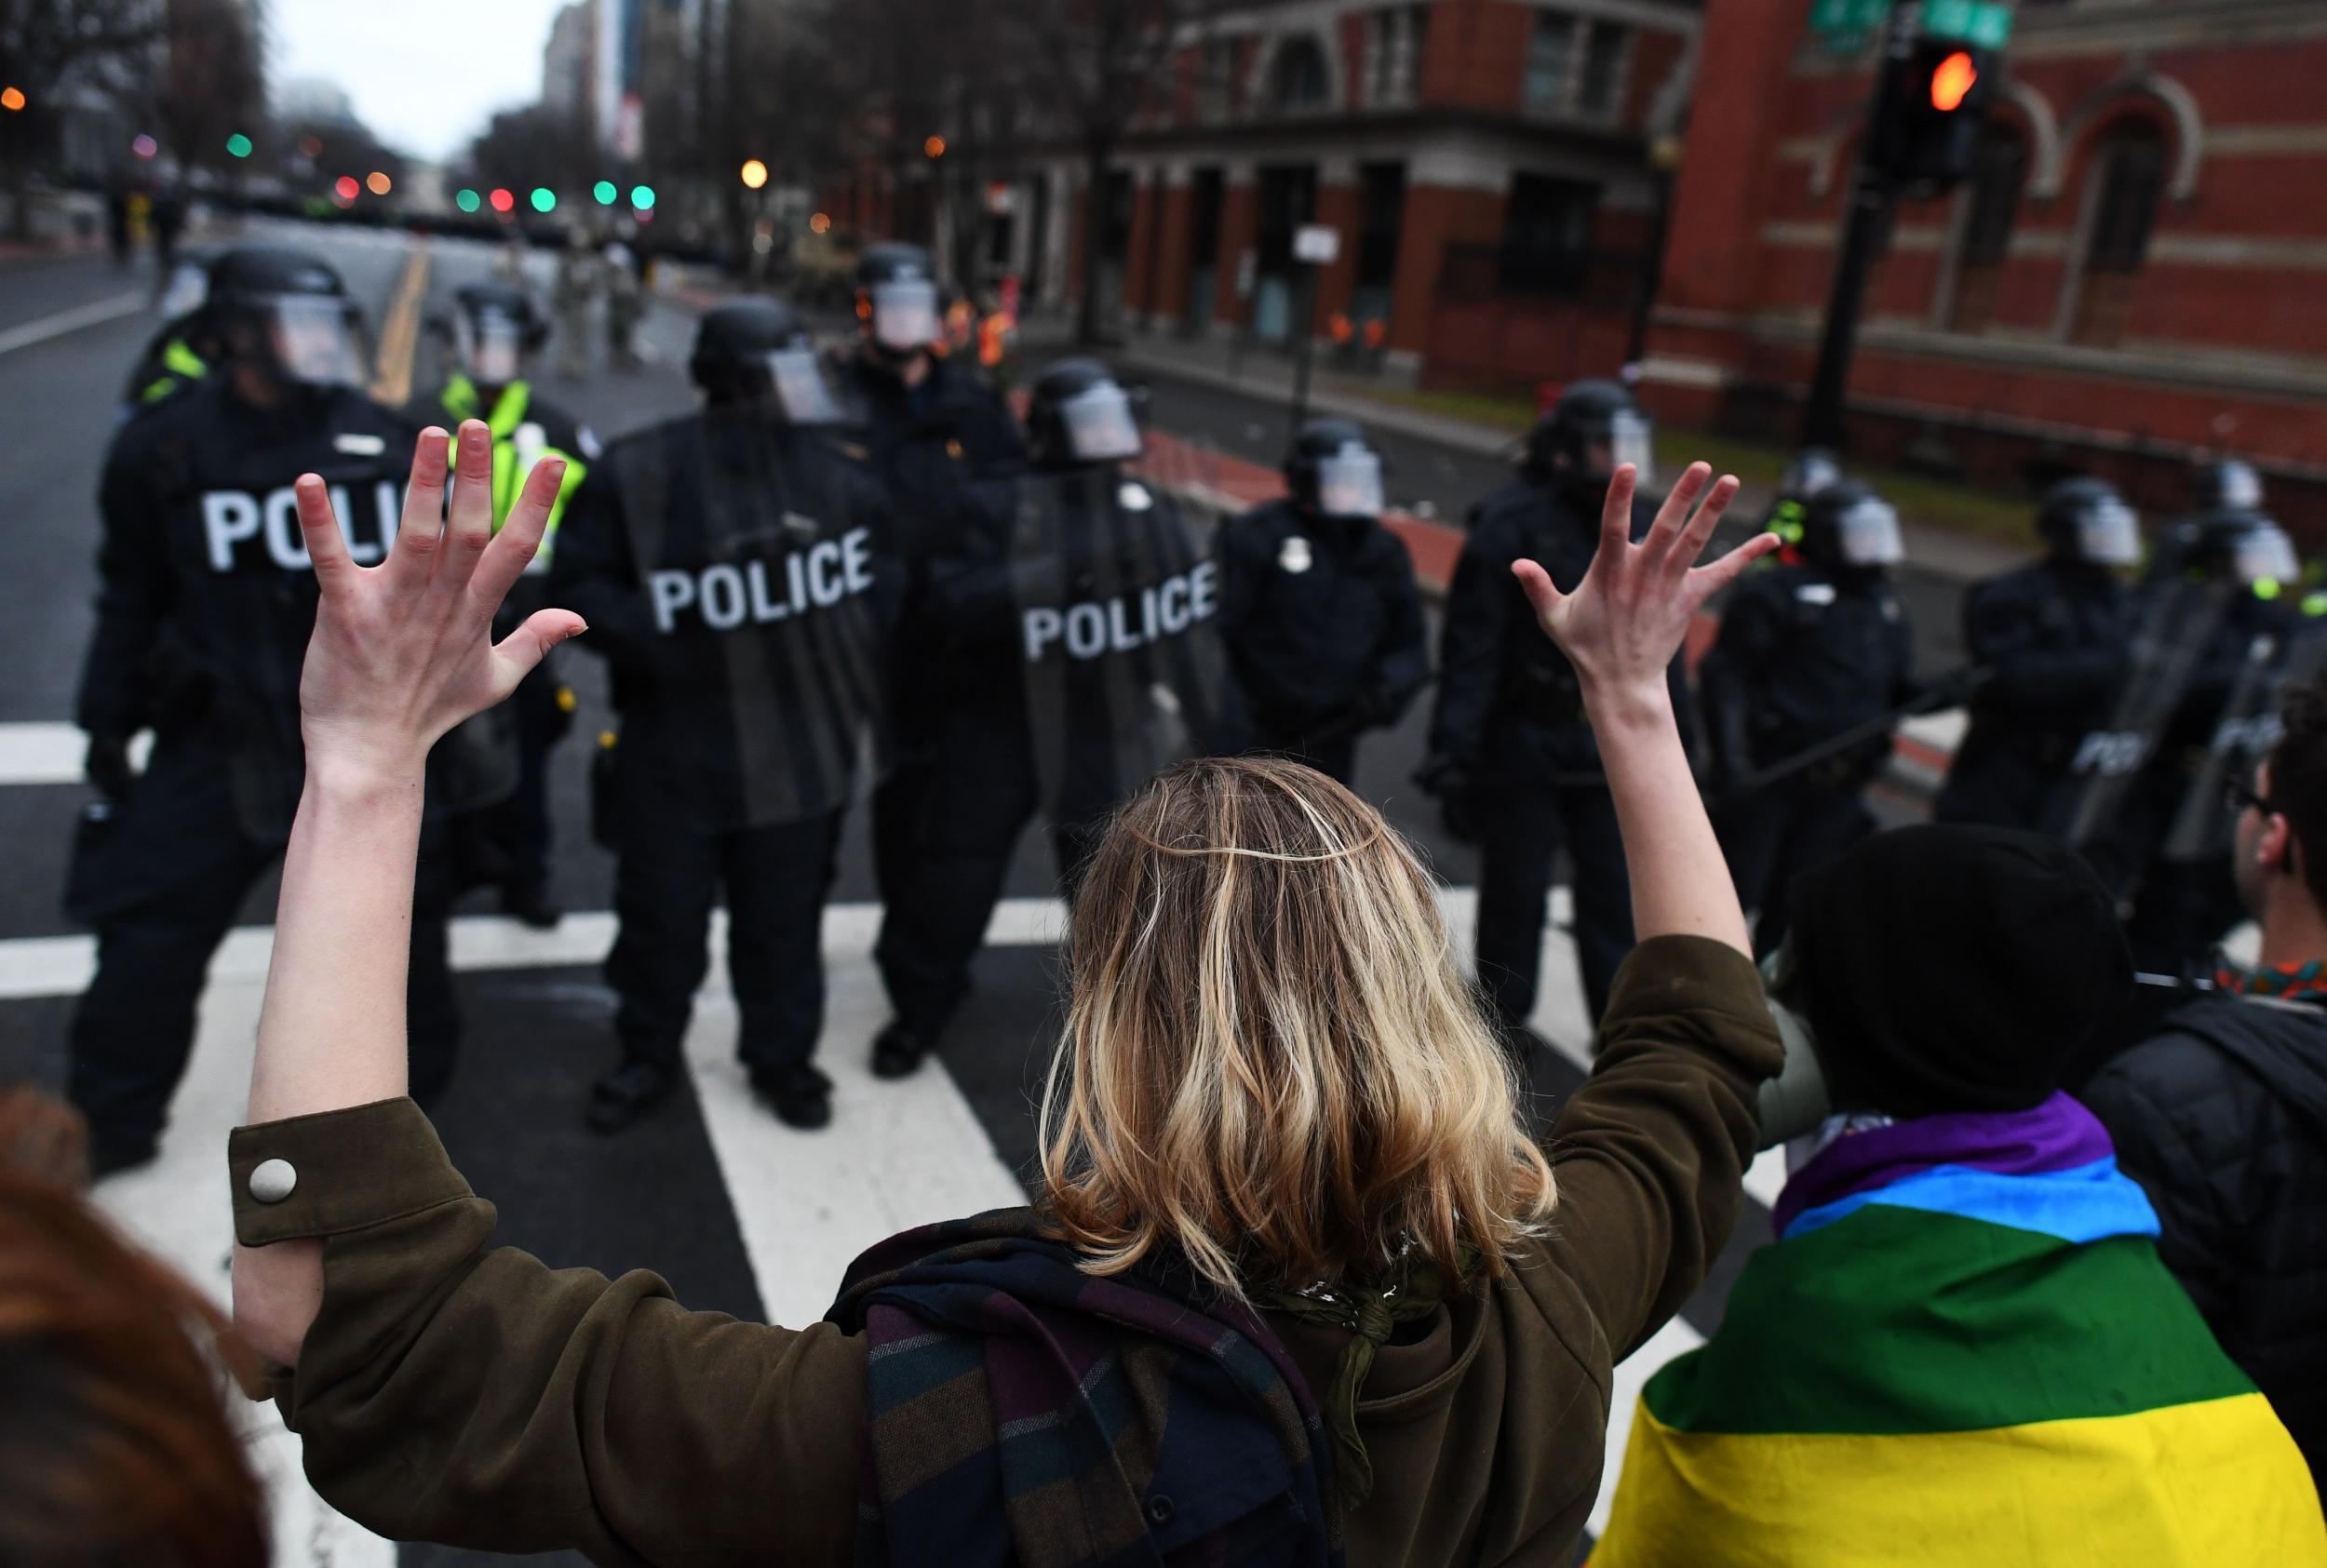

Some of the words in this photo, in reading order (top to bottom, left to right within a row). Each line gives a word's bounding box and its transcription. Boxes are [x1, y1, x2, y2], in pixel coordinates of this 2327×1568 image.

[201, 480, 424, 572] POLI
[651, 526, 873, 634] POLICE
[1025, 560, 1217, 662] POLICE
